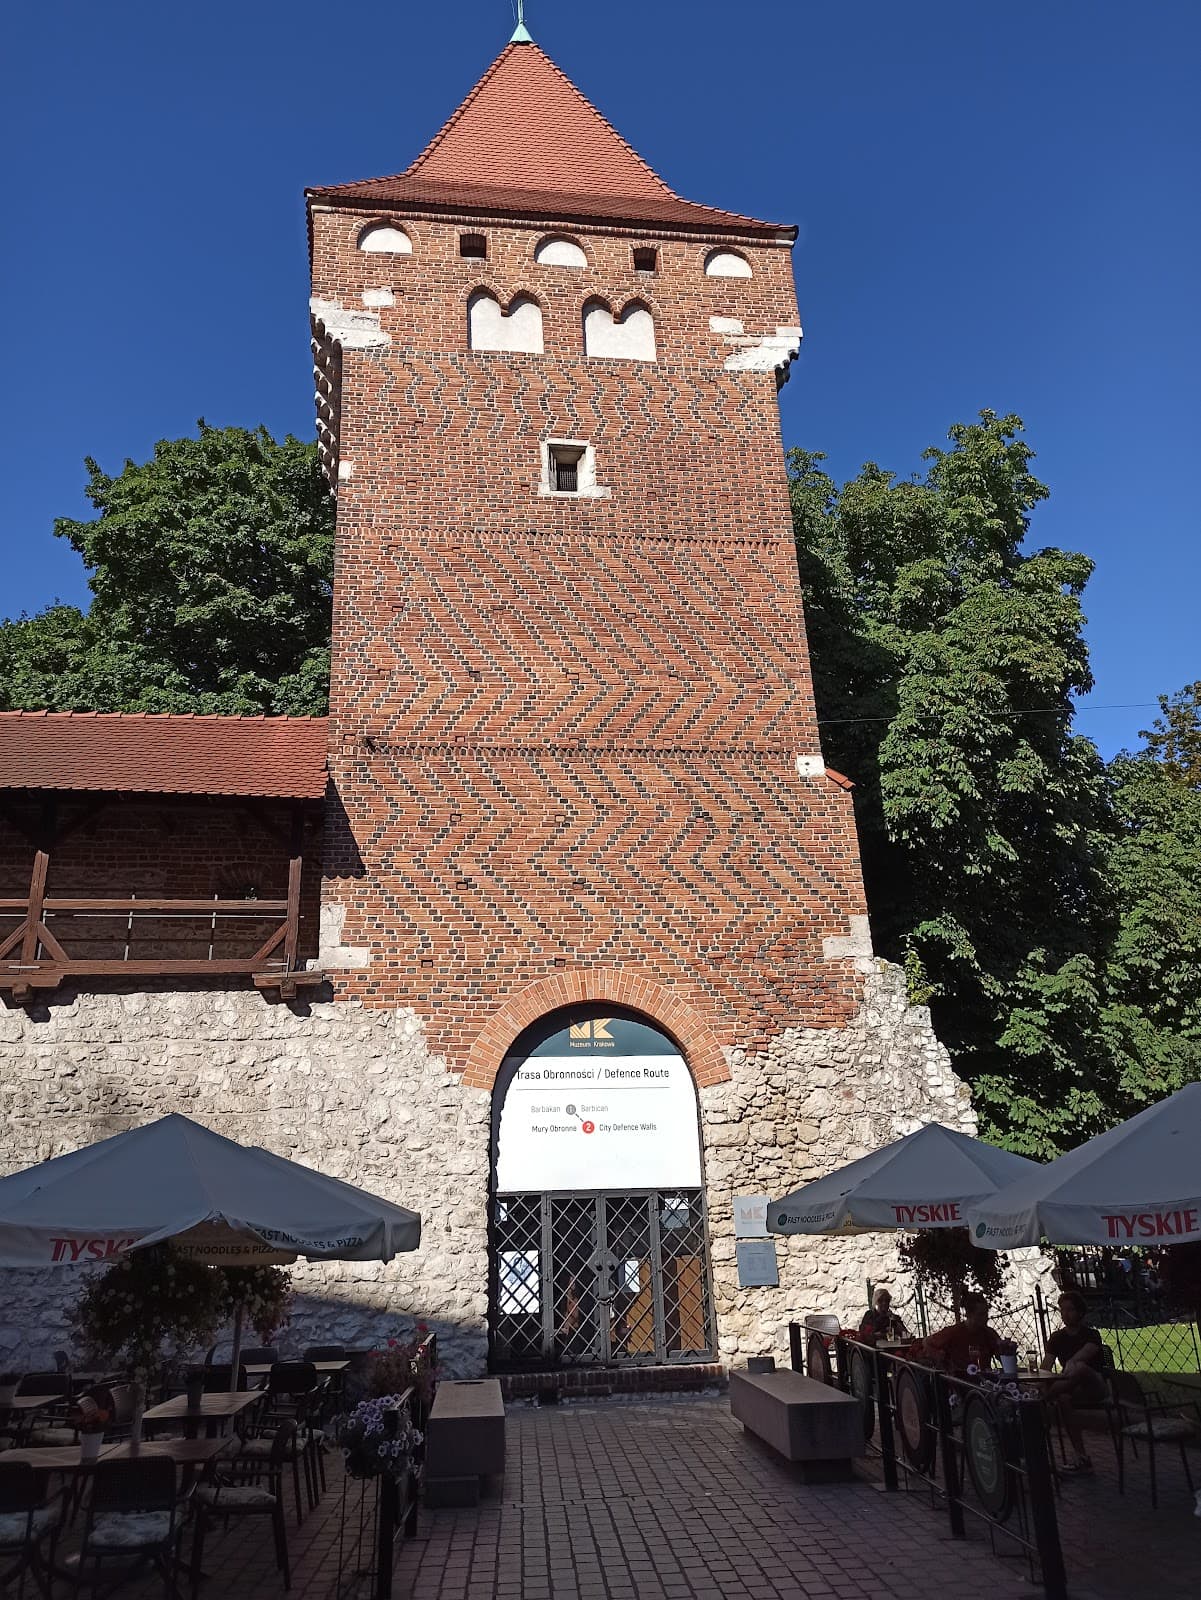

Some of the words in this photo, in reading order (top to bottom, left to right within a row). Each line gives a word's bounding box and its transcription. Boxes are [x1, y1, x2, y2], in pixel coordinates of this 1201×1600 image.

[570, 1018, 615, 1038] MK
[516, 1070, 541, 1080] Trasa
[543, 1068, 595, 1080] Obronności
[604, 1068, 641, 1079] Defence
[643, 1068, 670, 1078] Route
[530, 1105, 561, 1113] Barbakan
[581, 1104, 609, 1112] Barbican
[531, 1125, 548, 1133] Mury
[549, 1124, 577, 1132] Obronne
[599, 1124, 612, 1132] City
[612, 1123, 639, 1131] Defence
[640, 1123, 657, 1131] Walls
[891, 1203, 962, 1223] TYSKIE
[1101, 1208, 1200, 1238] TYSKIE
[337, 1236, 364, 1248] PIZZA
[194, 1246, 242, 1255] NOODLES
